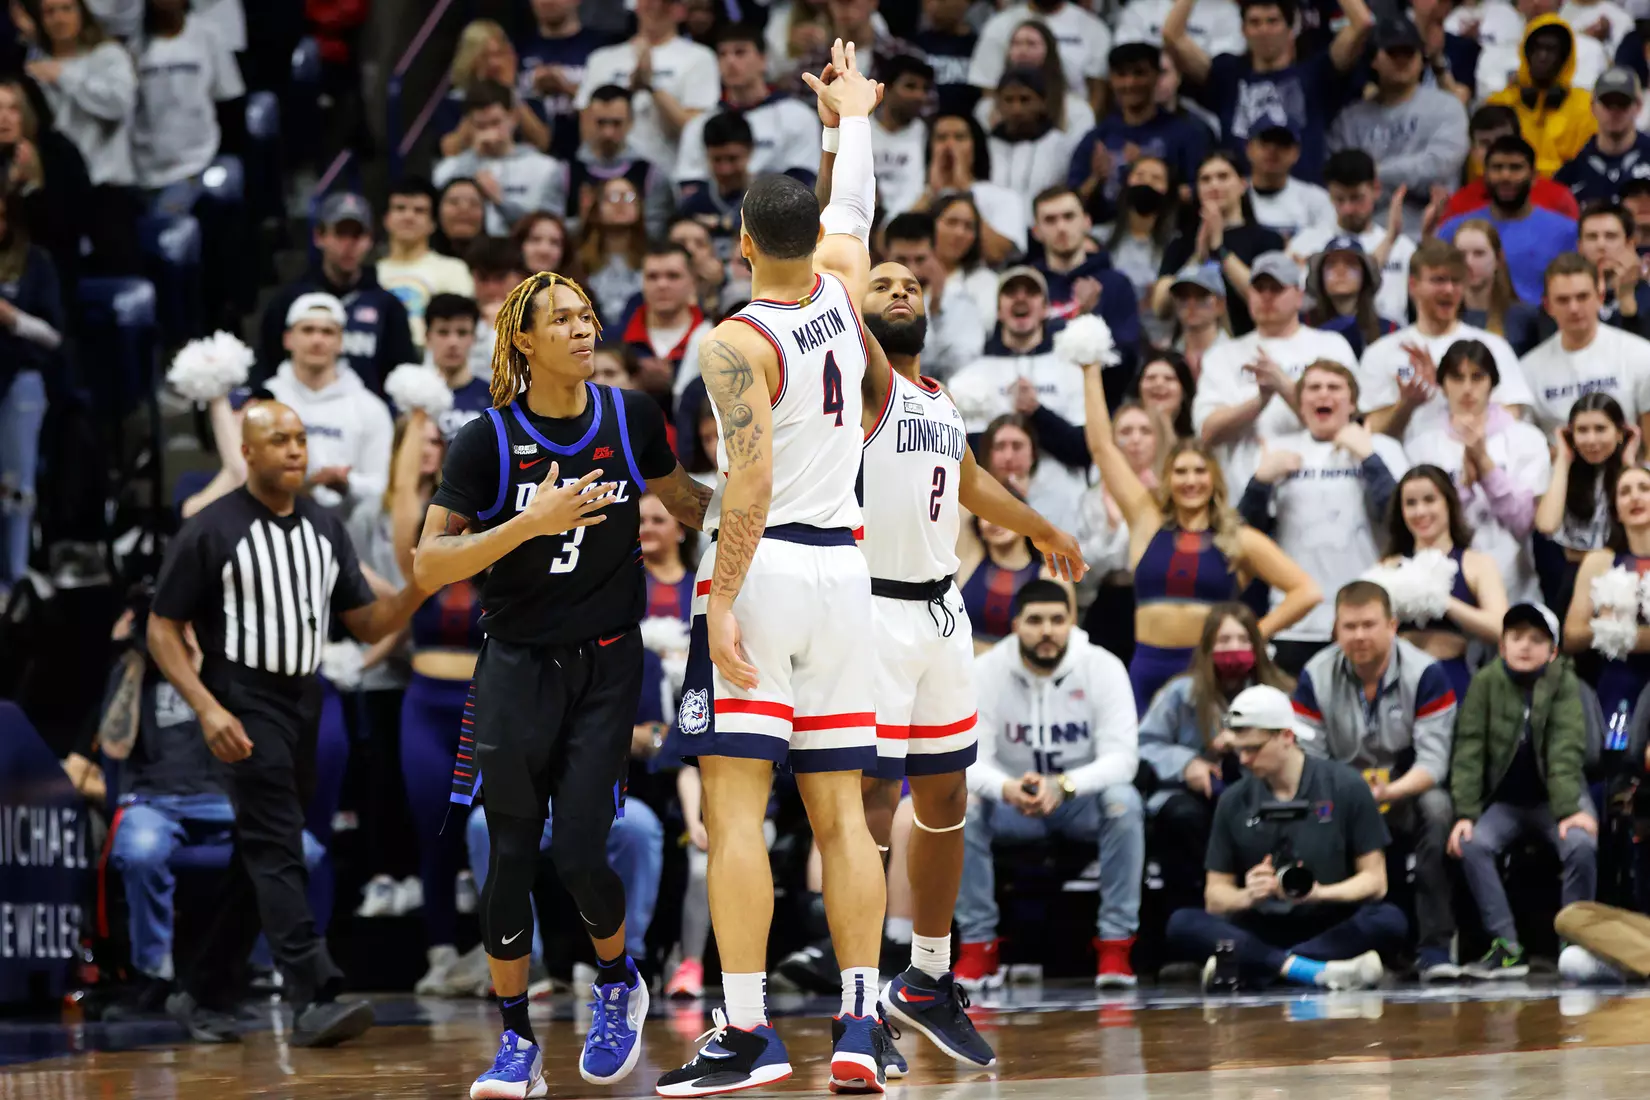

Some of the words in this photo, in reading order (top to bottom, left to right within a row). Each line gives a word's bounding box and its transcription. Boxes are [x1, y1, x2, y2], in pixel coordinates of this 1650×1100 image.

[792, 307, 846, 355] MARTIN
[823, 350, 844, 427] 4
[929, 465, 947, 522] 2
[548, 525, 587, 574] 3
[1005, 721, 1089, 746] UCNN
[0, 806, 88, 868] ICHAEL
[0, 902, 84, 960] EWELER
